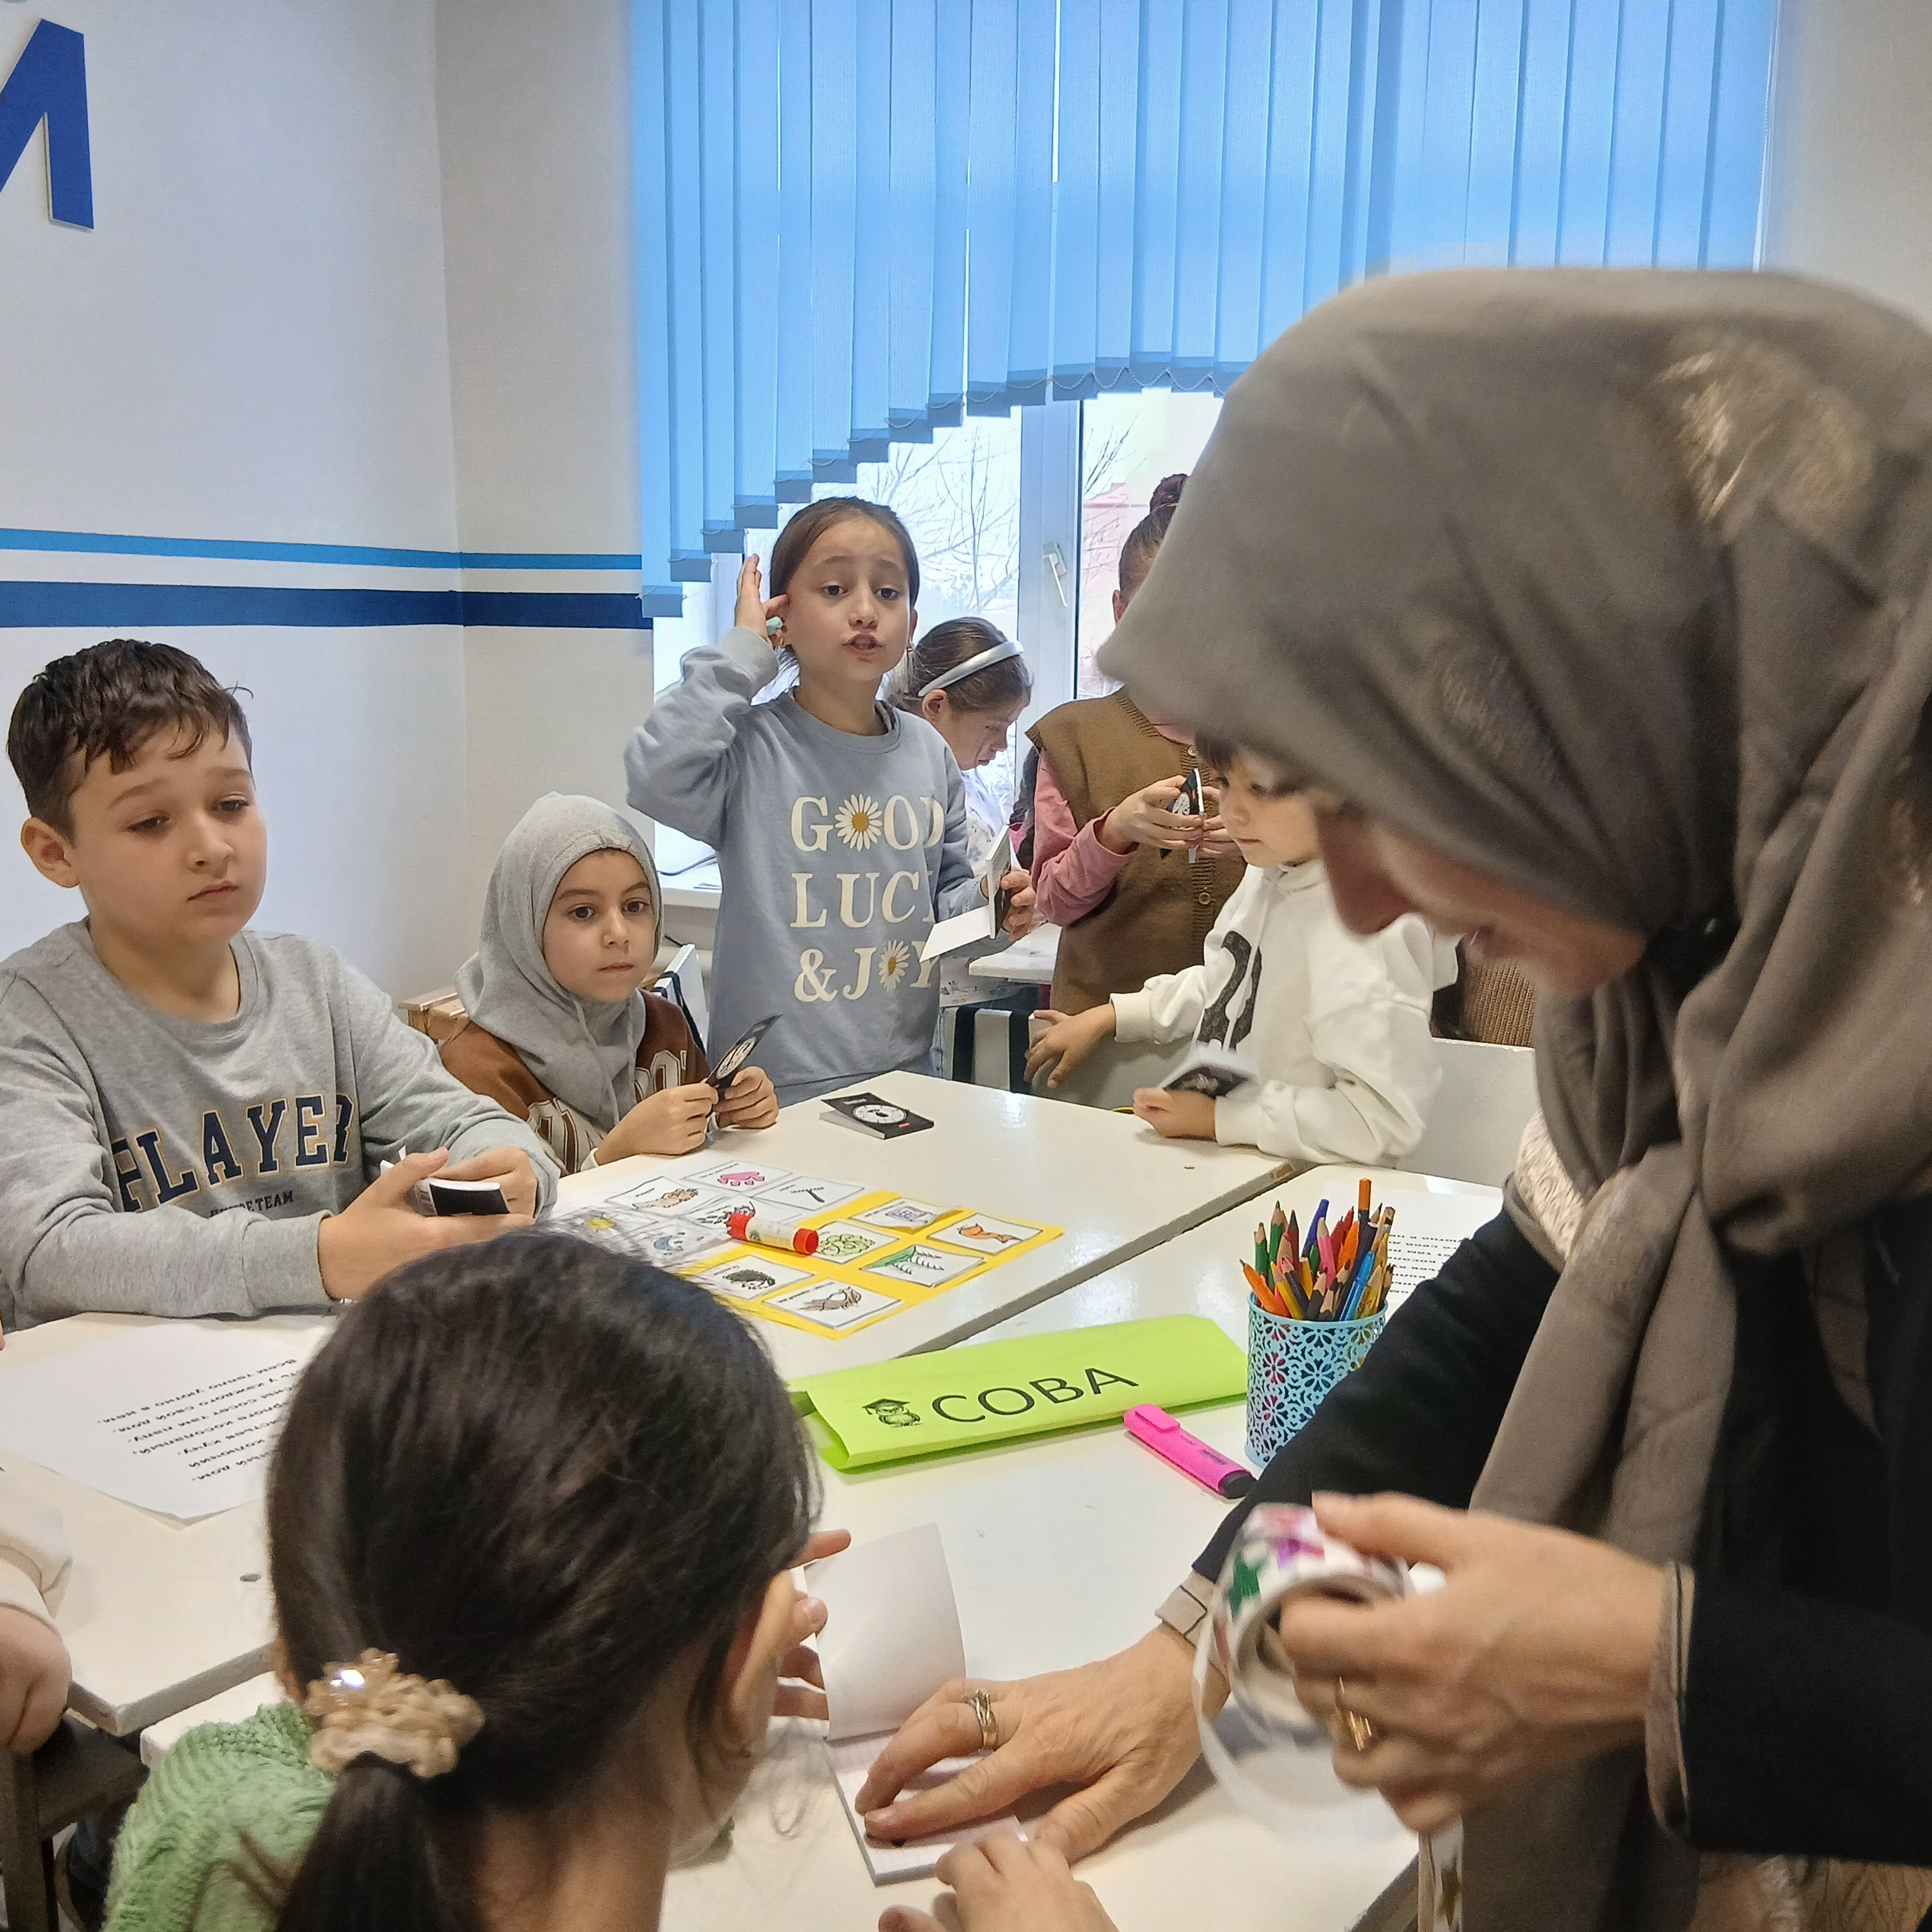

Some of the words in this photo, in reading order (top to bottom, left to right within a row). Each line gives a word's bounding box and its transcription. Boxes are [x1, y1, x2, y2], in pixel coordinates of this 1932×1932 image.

[794, 948, 838, 1003] &
[255, 1189, 293, 1212] TEAM
[931, 1366, 1139, 1422] СОВА
